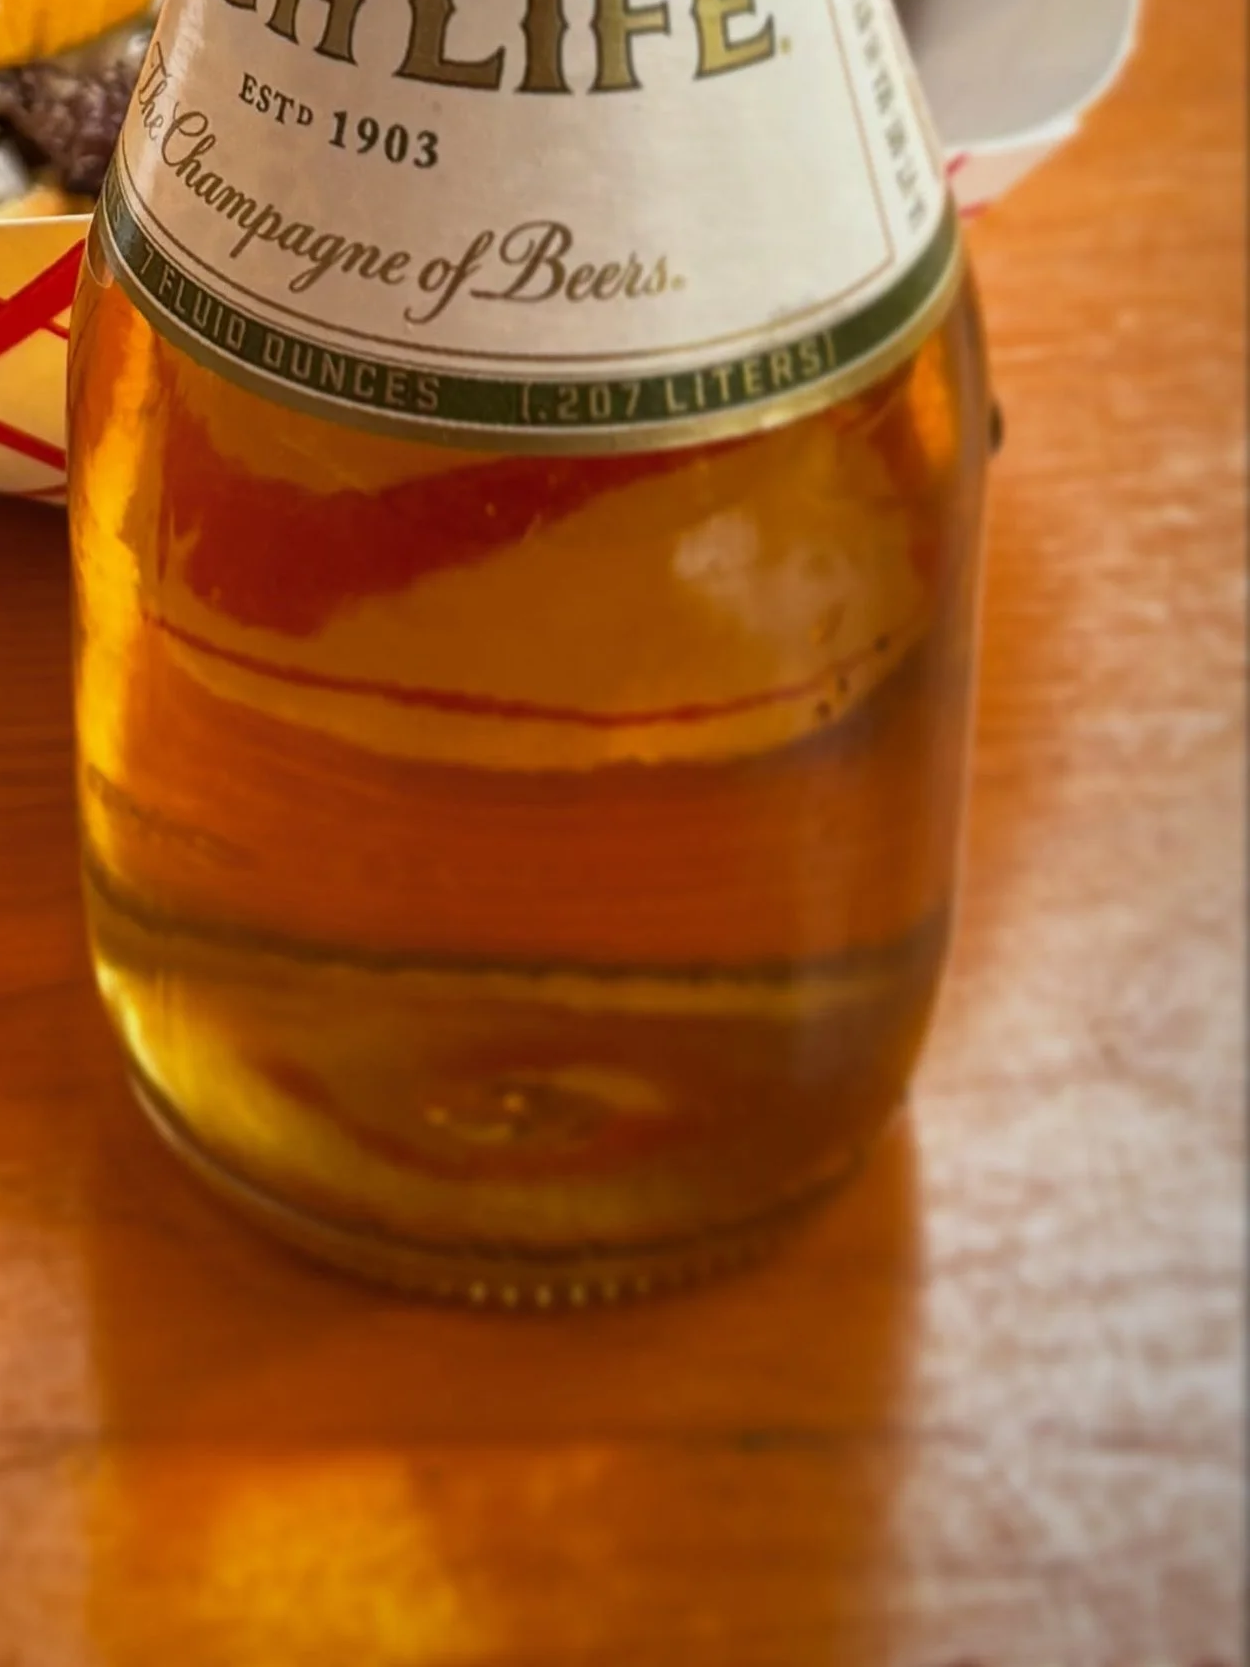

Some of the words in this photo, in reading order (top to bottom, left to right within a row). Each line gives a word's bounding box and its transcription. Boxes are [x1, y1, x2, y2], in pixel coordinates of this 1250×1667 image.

[137, 40, 173, 141] The
[160, 101, 412, 294] Champagne
[403, 229, 497, 326] of
[328, 110, 440, 170] 1903
[138, 241, 155, 276] 7
[157, 267, 247, 351] FLUID
[261, 332, 440, 412] OUNCES
